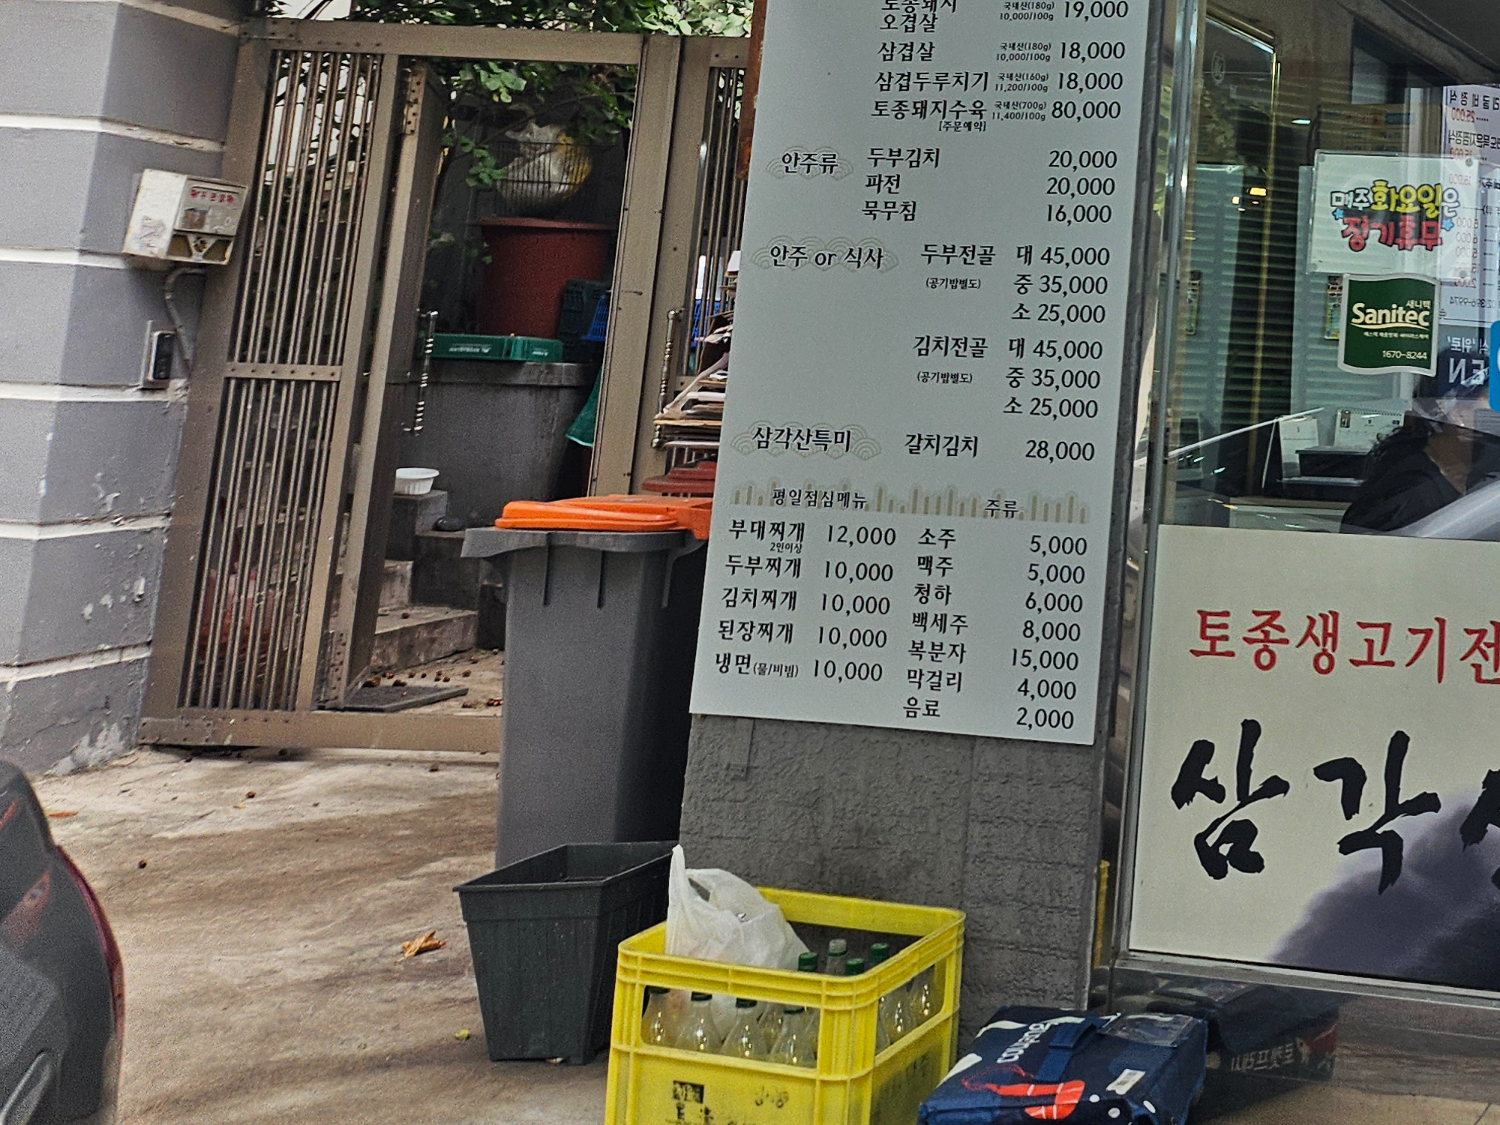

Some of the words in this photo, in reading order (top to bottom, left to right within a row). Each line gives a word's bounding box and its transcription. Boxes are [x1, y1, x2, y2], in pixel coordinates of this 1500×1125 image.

[879, 12, 939, 34] 오겹살
[999, 11, 1054, 22] 10,000/100g
[1004, 1, 1055, 11] 국내산(180g)
[1064, 0, 1129, 22] 19,000
[877, 41, 936, 62] 삼겹살
[1000, 42, 1052, 52] 국내산(180g)
[1061, 41, 1126, 64] 18,000
[996, 52, 1051, 63] 10,000/100g
[874, 71, 989, 93] 삼겹두루치기
[998, 72, 1049, 83] 국내산(160g)
[1058, 72, 1124, 94] 18,000
[995, 83, 1048, 93] 11,200/100g
[870, 99, 988, 121] 토종돼지수육
[994, 100, 1047, 111] 국내산(700g)
[1051, 100, 1122, 123] 80,000
[992, 111, 1046, 122] 11,400/100g
[781, 152, 839, 175] 안주류
[867, 147, 940, 169] 두부김치
[1048, 150, 1118, 173] 20,000
[864, 173, 901, 195] 파전
[1046, 176, 1116, 200] 20,000
[1330, 186, 1372, 211] 매주
[1370, 179, 1460, 219] 화요일은
[861, 200, 917, 222] 묵무침
[1047, 204, 1112, 227] 16,000
[1341, 214, 1443, 253] 정기휴무
[770, 245, 808, 268] 안주
[814, 252, 838, 266] or
[843, 247, 885, 270] 식사
[920, 244, 997, 266] 두부전골
[1016, 244, 1033, 267] 대
[1040, 246, 1110, 269] 45,000
[1013, 273, 1034, 295] 중
[1039, 274, 1108, 298] 35,000
[1011, 302, 1031, 320] 소
[1037, 303, 1106, 327] 25,000
[1351, 302, 1430, 327] Sanitec
[913, 334, 989, 359] 김치전골
[1008, 337, 1026, 360] 대
[1032, 339, 1103, 363] 45,000
[1381, 350, 1428, 360] 1670-8244
[1005, 366, 1026, 389] 중
[1031, 368, 1101, 392] 35,000
[1002, 396, 1023, 414] 소
[1029, 397, 1099, 421] 25,000
[752, 426, 851, 453] 삼각산특미
[904, 432, 979, 458] 갈치김치
[1025, 439, 1095, 464] 28,000
[772, 488, 867, 510] 평일점심메뉴
[984, 499, 1019, 519] 주류
[728, 519, 806, 544] 부대찌개
[828, 524, 897, 548] 12,000
[917, 528, 956, 550] 소주
[1029, 534, 1088, 558] 5,000
[769, 541, 803, 554] 2인이상
[725, 554, 802, 579] 두부찌개
[825, 560, 894, 584] 10,000
[917, 555, 954, 578] 맥주
[1027, 563, 1086, 586] 5,000
[722, 586, 798, 612] 김치찌개
[822, 593, 891, 617] 10,000
[913, 583, 952, 606] 청하
[1025, 591, 1083, 615] 6,000
[718, 619, 794, 644] 된장찌개
[818, 626, 887, 650] 10,000
[912, 611, 969, 636] 백세주
[1022, 619, 1081, 643] 8,000
[814, 659, 883, 683] 10,000
[908, 639, 967, 665] 복분자
[1012, 648, 1079, 672] 15,000
[907, 668, 962, 693] 막걸리
[1017, 678, 1077, 701] 4,000
[902, 696, 941, 719] 음료
[1016, 706, 1074, 731] 2,000
